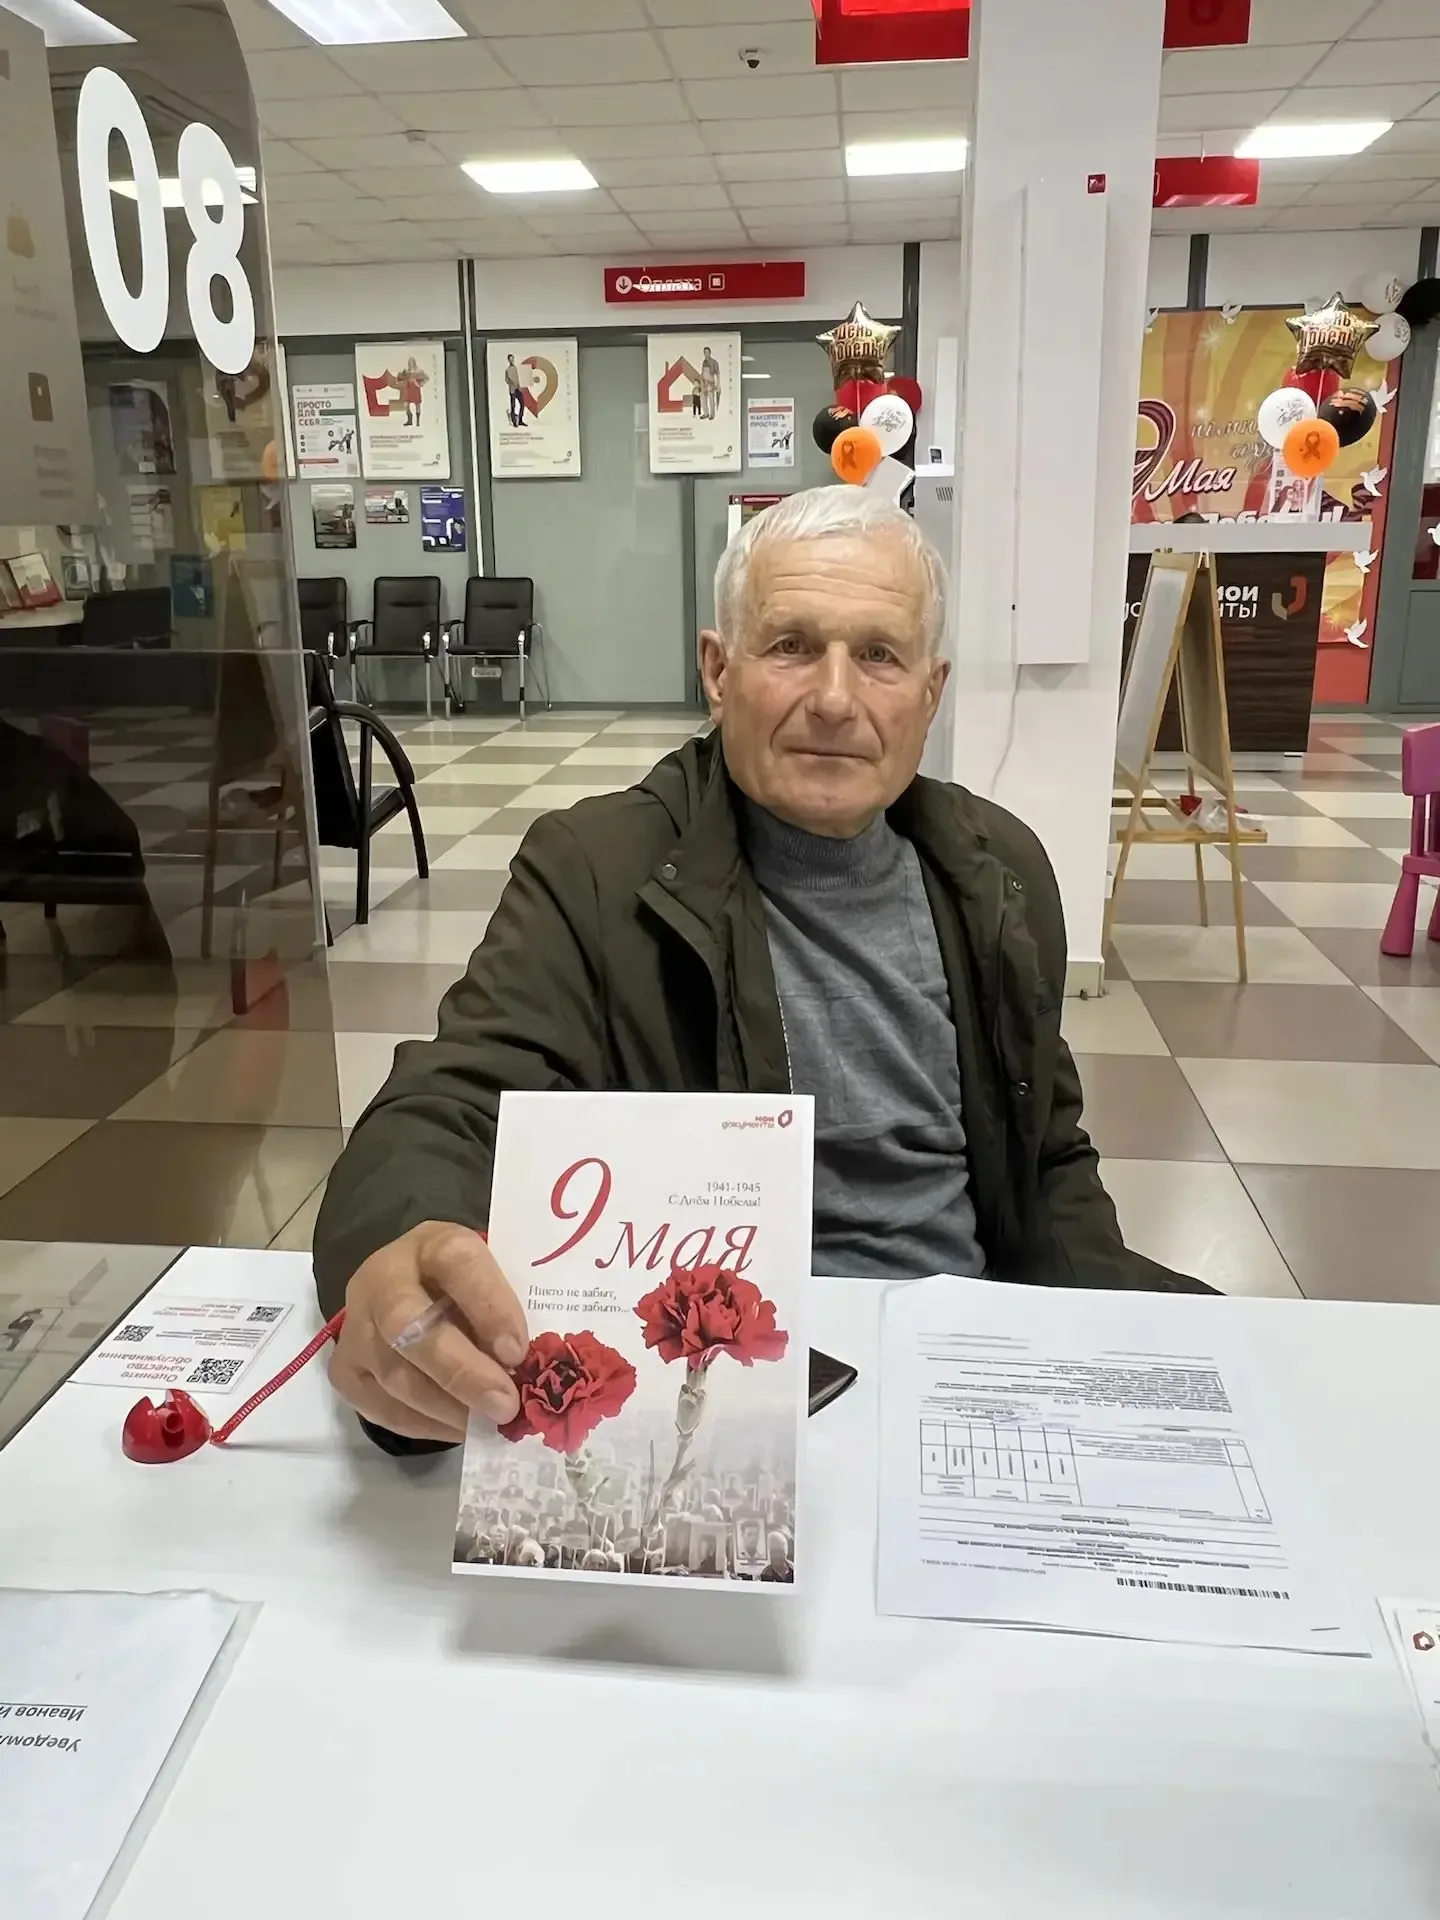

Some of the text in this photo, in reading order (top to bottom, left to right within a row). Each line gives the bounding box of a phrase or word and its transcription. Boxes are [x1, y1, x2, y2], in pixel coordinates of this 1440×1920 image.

[77, 66, 255, 374] 08
[297, 400, 332, 409] ПРОСТО
[297, 410, 317, 418] ДЛЯ
[298, 418, 321, 426] СЕБЯ
[1145, 458, 1237, 502] Мая
[706, 1182, 761, 1193] 1941-1945
[531, 1157, 758, 1273] 9 мая
[528, 1285, 617, 1300] Никто не забыт,
[527, 1299, 564, 1311] Ничто
[566, 1303, 580, 1312] не
[99, 1352, 193, 1365] обслуживания
[126, 1362, 186, 1373] качество
[120, 1371, 178, 1383] Оцените
[14, 1706, 85, 1721] Иванов
